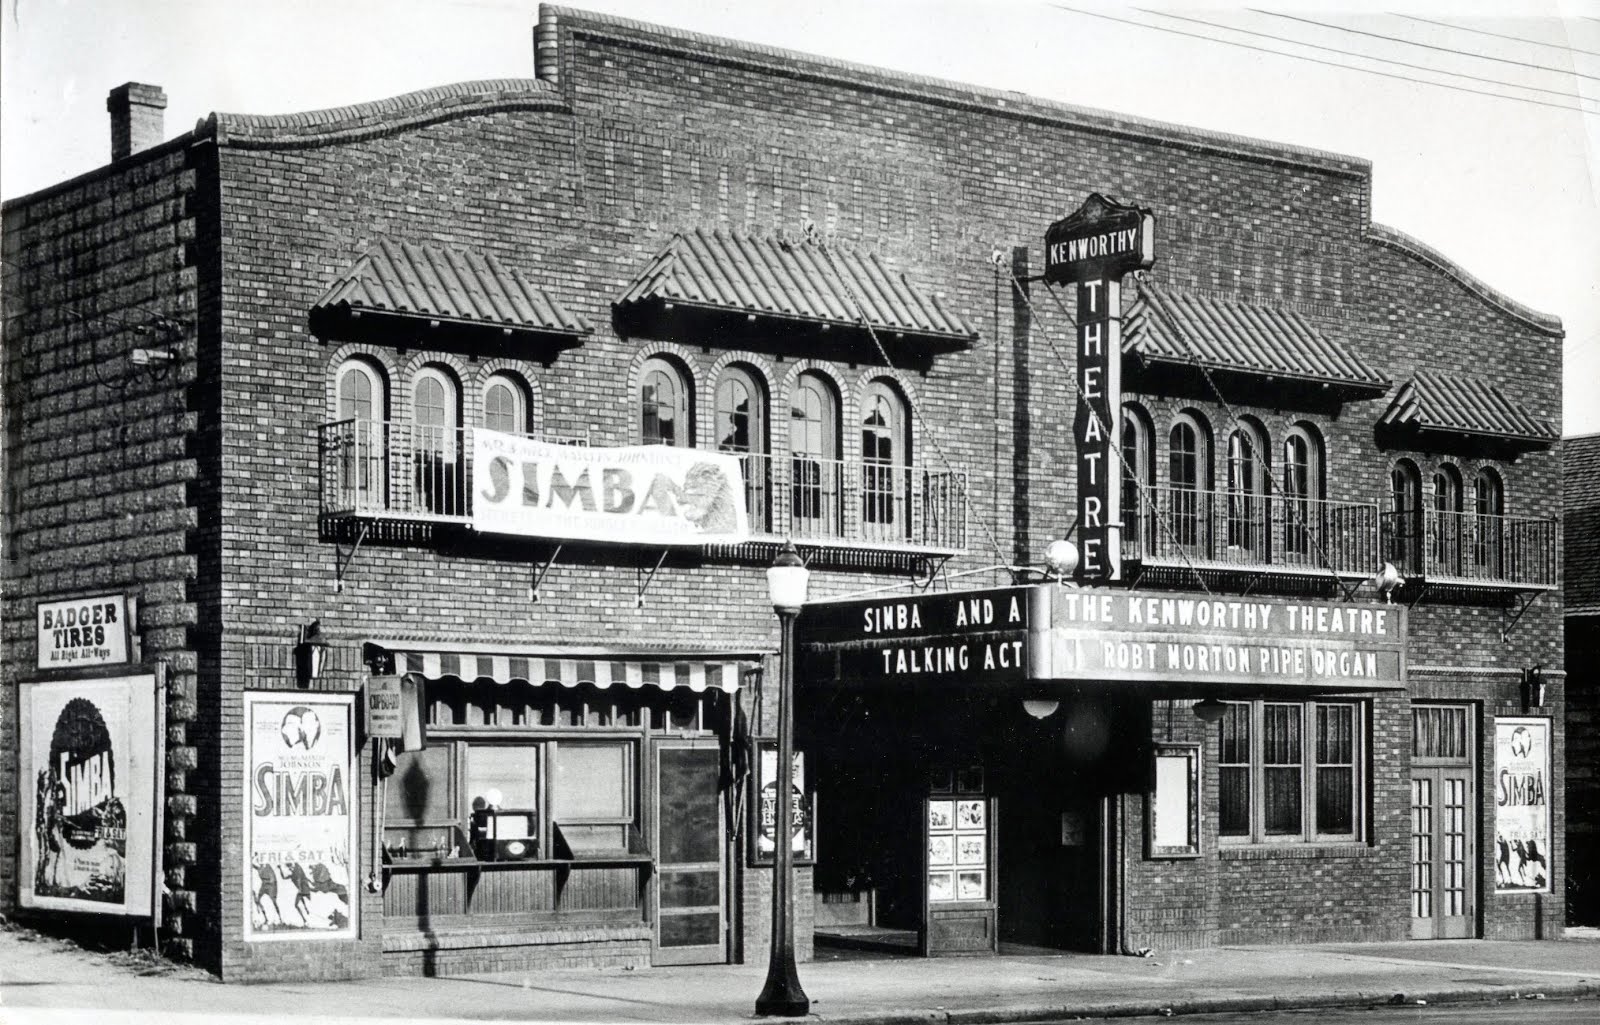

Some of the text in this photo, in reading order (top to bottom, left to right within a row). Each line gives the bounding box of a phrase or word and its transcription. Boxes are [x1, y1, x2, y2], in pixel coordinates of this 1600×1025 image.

[1050, 228, 1138, 265] KENWORTHY
[1084, 279, 1102, 572] THEATRE
[480, 455, 679, 516] SIMBA
[43, 603, 117, 630] BADGER
[864, 596, 1021, 633] SIMBA AND A
[1066, 594, 1387, 635] THE KENWORTHY THEATRE
[50, 650, 60, 661] All
[61, 649, 78, 662] Right
[53, 625, 105, 649] TIRES
[883, 641, 1023, 674] TALKING ACT
[1104, 640, 1377, 677] ROBT MORTON PIPE ORGAN
[60, 750, 113, 817] SIMBA
[253, 761, 348, 817] SIMBA
[1497, 767, 1546, 807] SIMBA
[259, 850, 324, 862] FRI & SAT
